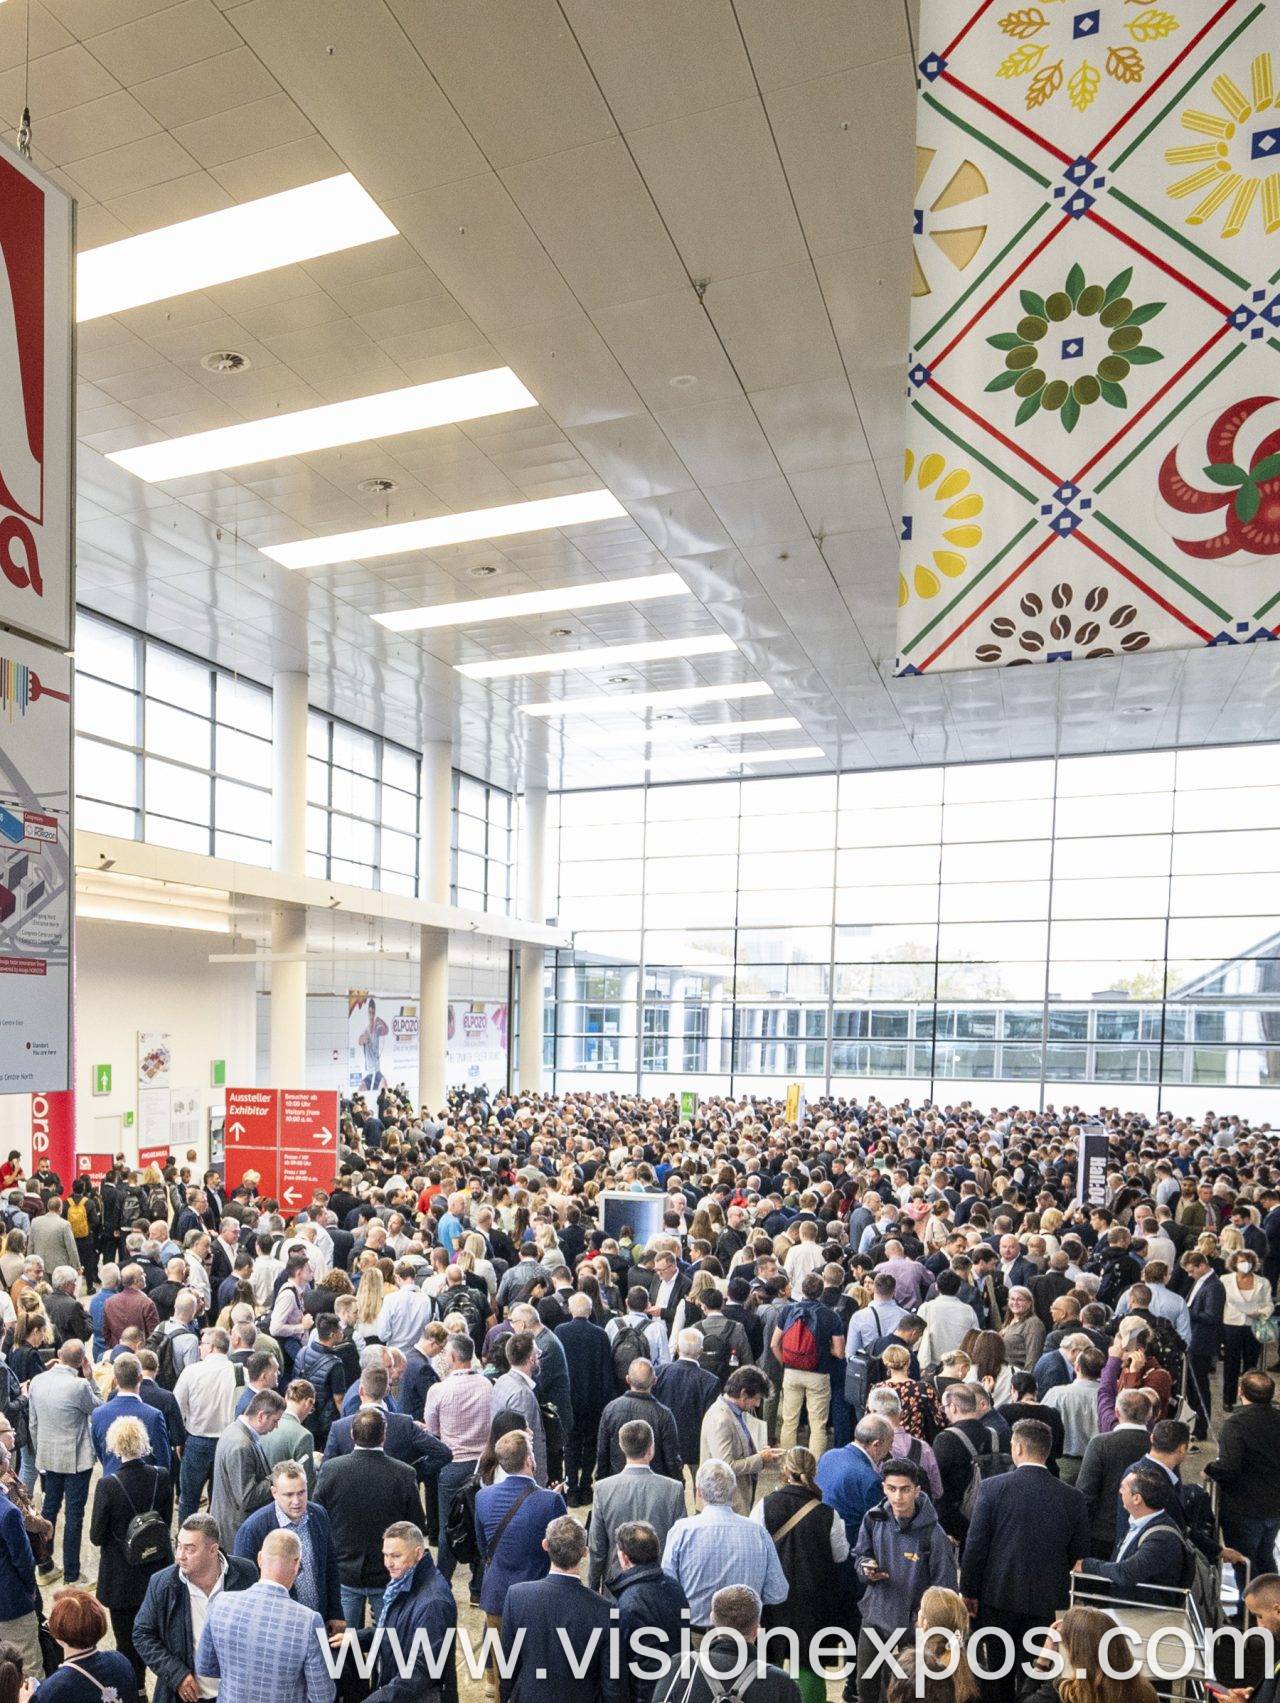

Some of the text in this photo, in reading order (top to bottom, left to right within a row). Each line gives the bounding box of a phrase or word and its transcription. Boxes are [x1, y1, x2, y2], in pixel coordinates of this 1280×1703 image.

[229, 1092, 271, 1103] Aussteller
[229, 1105, 270, 1116] Exhibitor
[32, 1093, 50, 1152] ore
